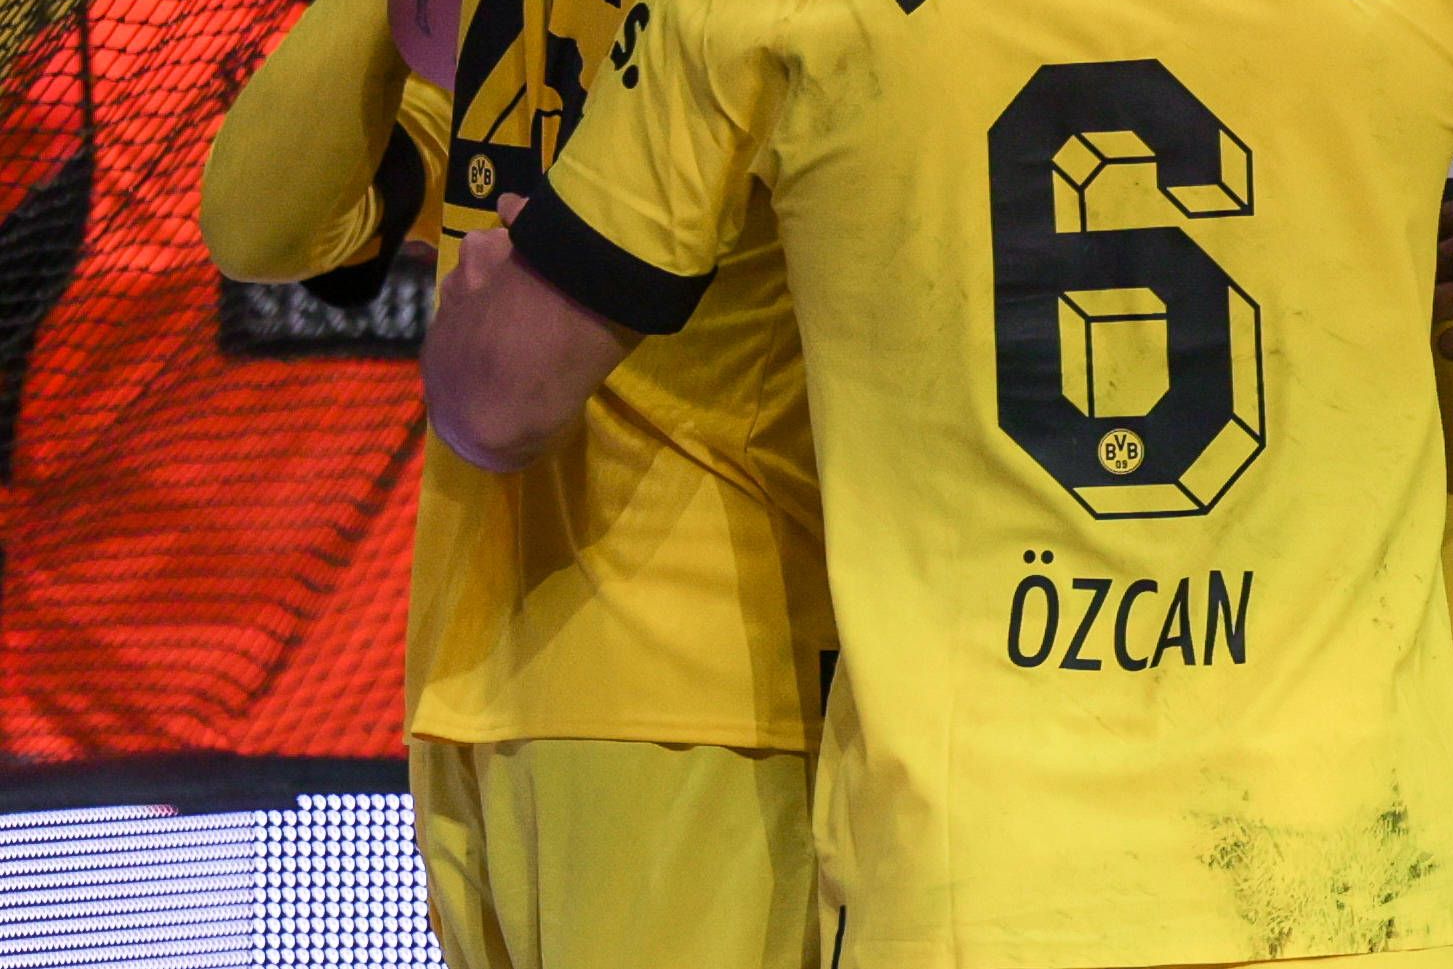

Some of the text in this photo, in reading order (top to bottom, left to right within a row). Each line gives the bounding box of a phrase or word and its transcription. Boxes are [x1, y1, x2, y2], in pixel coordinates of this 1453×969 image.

[470, 158, 493, 186] BVB
[987, 58, 1266, 521] 6
[1105, 434, 1139, 461] BVB
[1005, 549, 1254, 672] ÖZCAN
